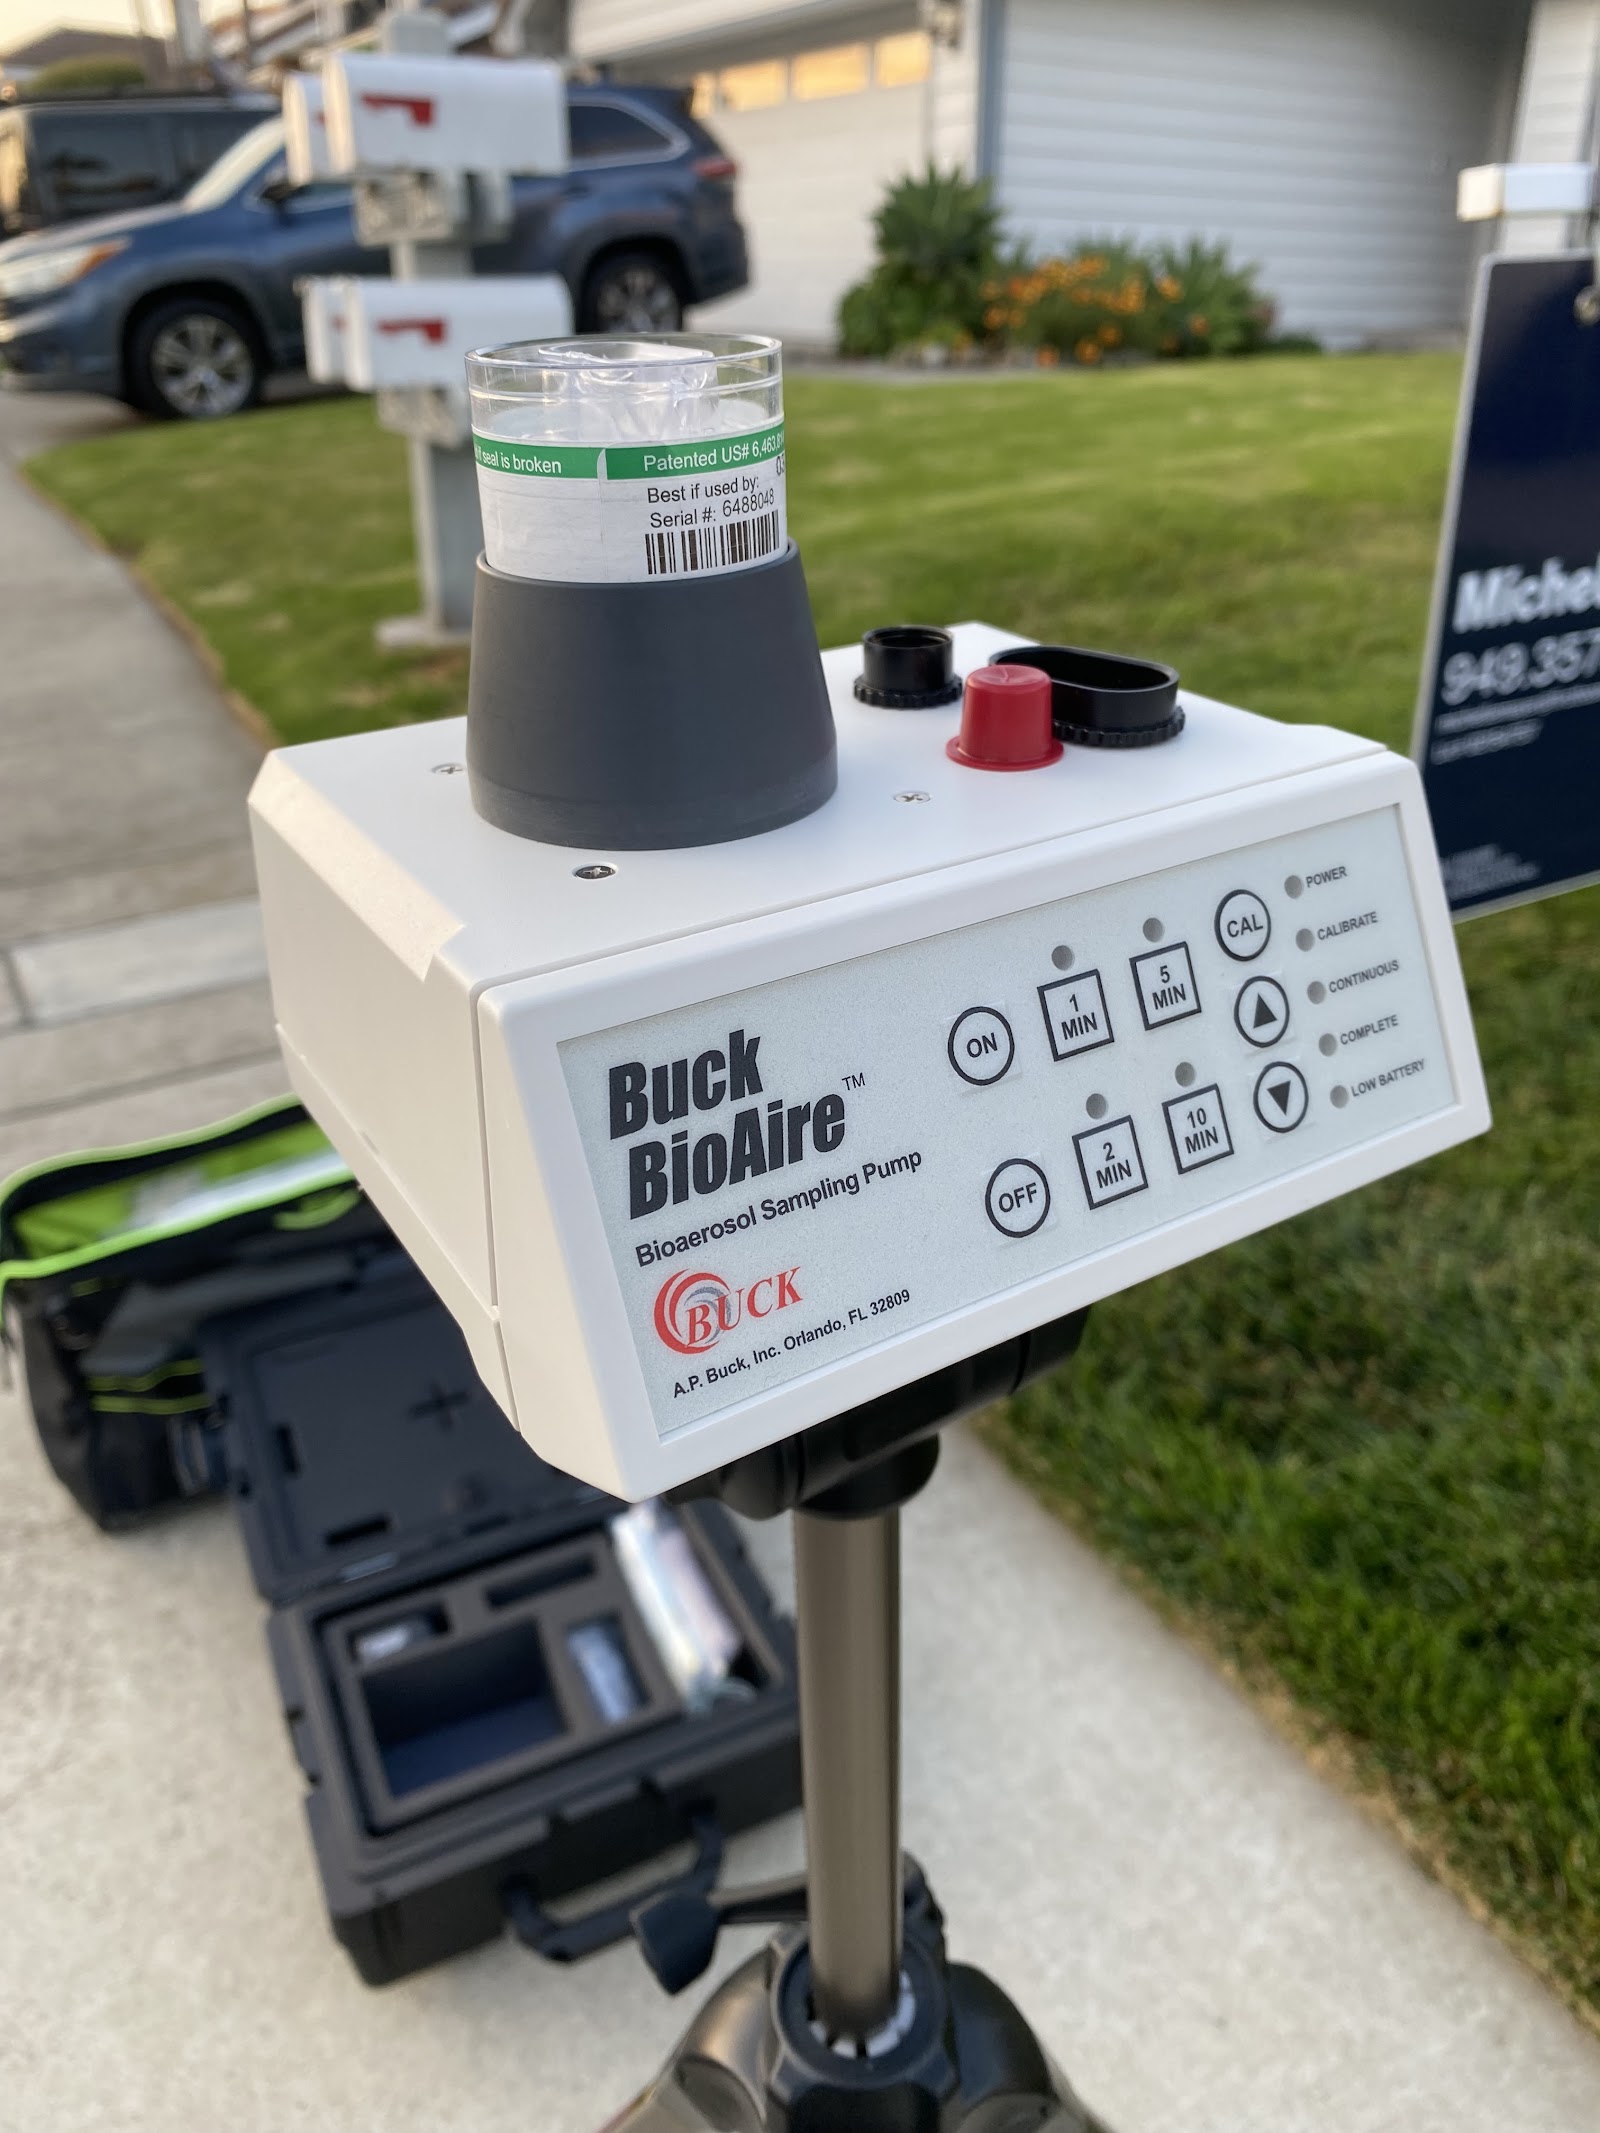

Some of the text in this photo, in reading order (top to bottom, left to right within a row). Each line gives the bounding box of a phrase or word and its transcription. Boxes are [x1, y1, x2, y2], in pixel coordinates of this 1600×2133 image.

[482, 450, 500, 468] seal
[500, 452, 511, 470] is
[513, 453, 562, 475] broken
[643, 448, 718, 472] Patented
[721, 442, 750, 464] US#
[647, 475, 760, 504] Best if used by:
[650, 488, 775, 529] Serial #: 6488048
[1305, 865, 1348, 889] POWER
[1226, 913, 1264, 939] CAL
[1317, 911, 1379, 941] CALIBRATE
[1159, 965, 1171, 984] 5
[1328, 959, 1400, 994] CONTINUOUS
[1069, 993, 1080, 1012] 1
[1152, 983, 1188, 1011] MIN
[1061, 1012, 1098, 1041] MIN
[1340, 1014, 1399, 1046] COMPLETE
[966, 1032, 998, 1060] ON
[608, 1028, 764, 1140] Buck
[1351, 1058, 1426, 1098] LOW BATTERY
[1186, 1106, 1208, 1127] 10
[1103, 1142, 1116, 1162] 2
[1184, 1126, 1220, 1155] MIN
[628, 1093, 846, 1221] BioAire
[1096, 1159, 1133, 1189] MIN
[634, 1150, 923, 1268] Bioaerosol Sampling Pump
[998, 1181, 1038, 1214] OFF
[685, 1266, 804, 1348] BUCK
[673, 1288, 911, 1398] A.P. Buck, Inc. Orlando, FL 32809
